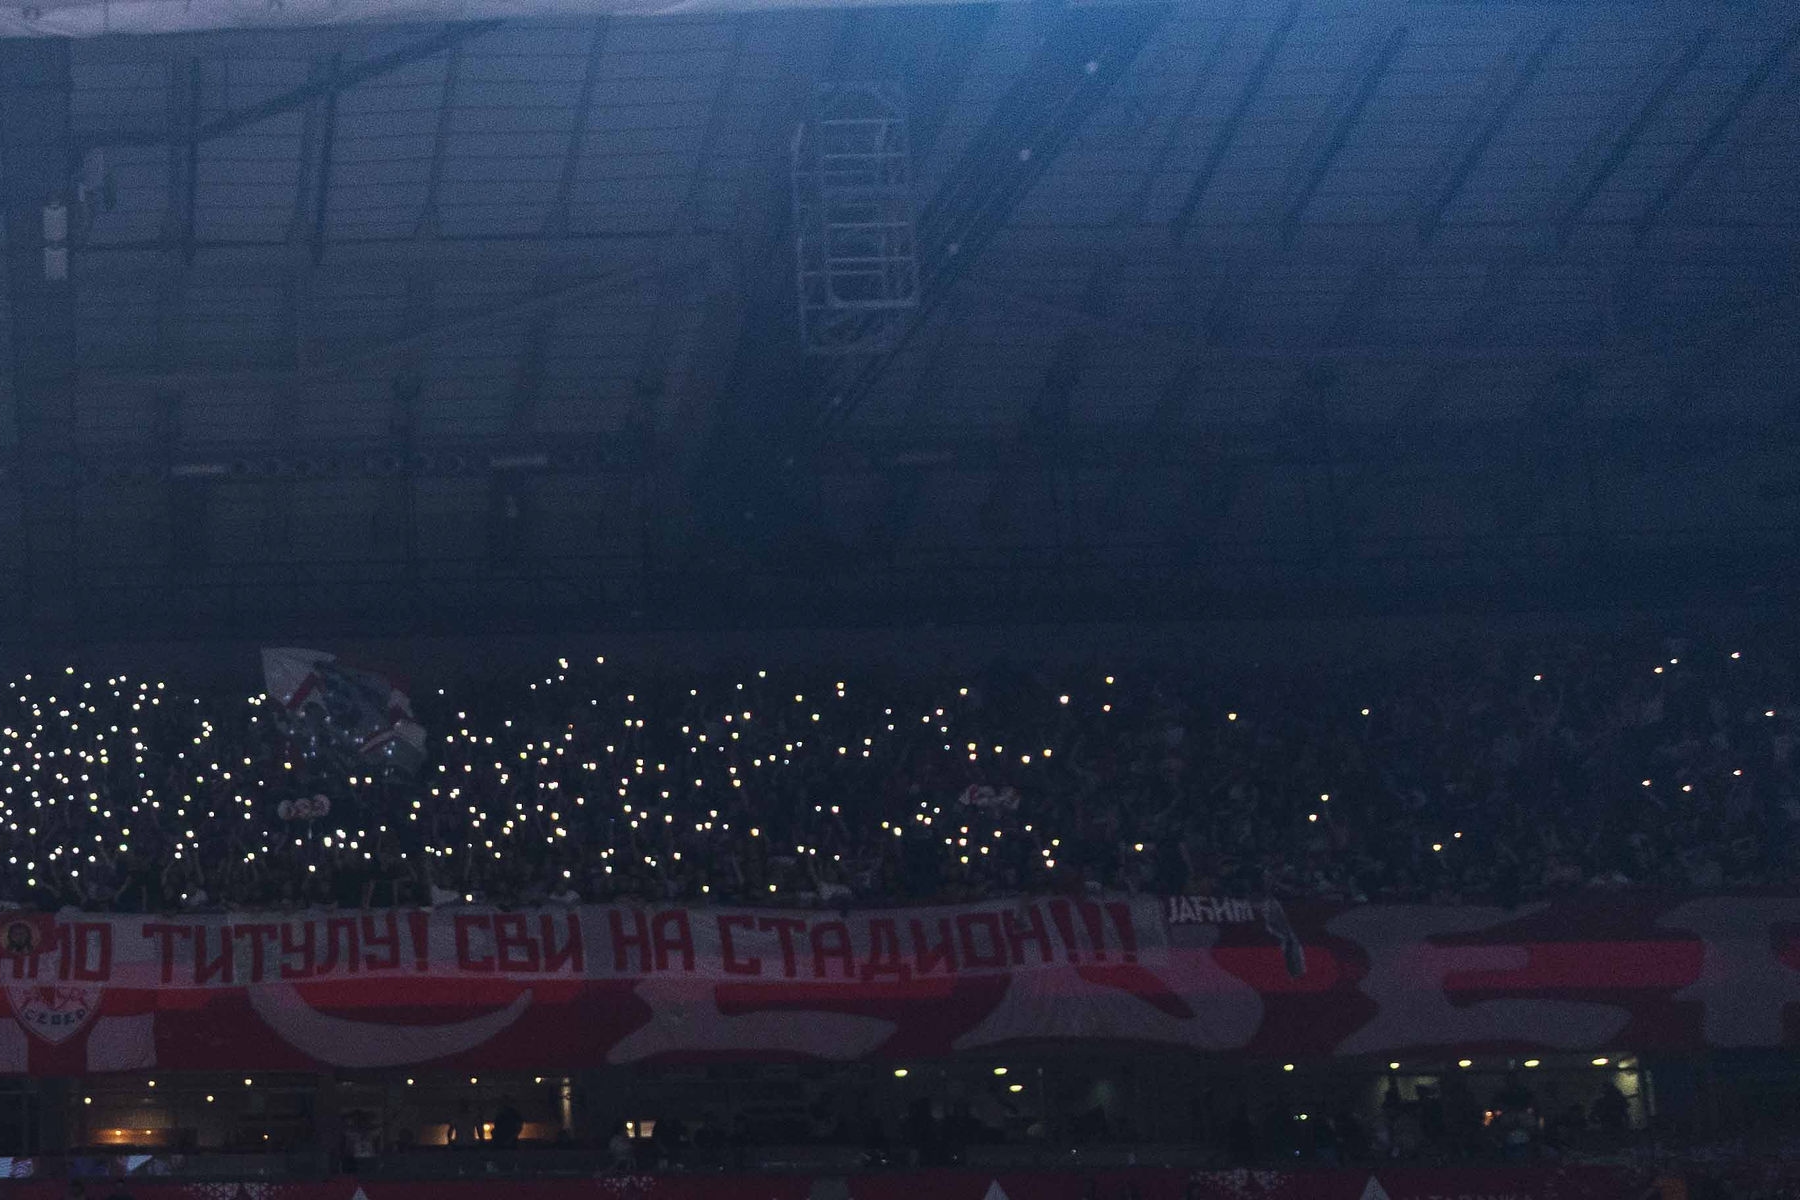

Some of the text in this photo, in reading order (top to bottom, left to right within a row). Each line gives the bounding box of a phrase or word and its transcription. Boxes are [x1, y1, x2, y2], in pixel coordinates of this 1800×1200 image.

[142, 912, 428, 982] ТИТУЛУ!
[454, 912, 584, 973] СВИ
[608, 909, 694, 973] НА
[717, 899, 1138, 982] СТАДИОН!!!
